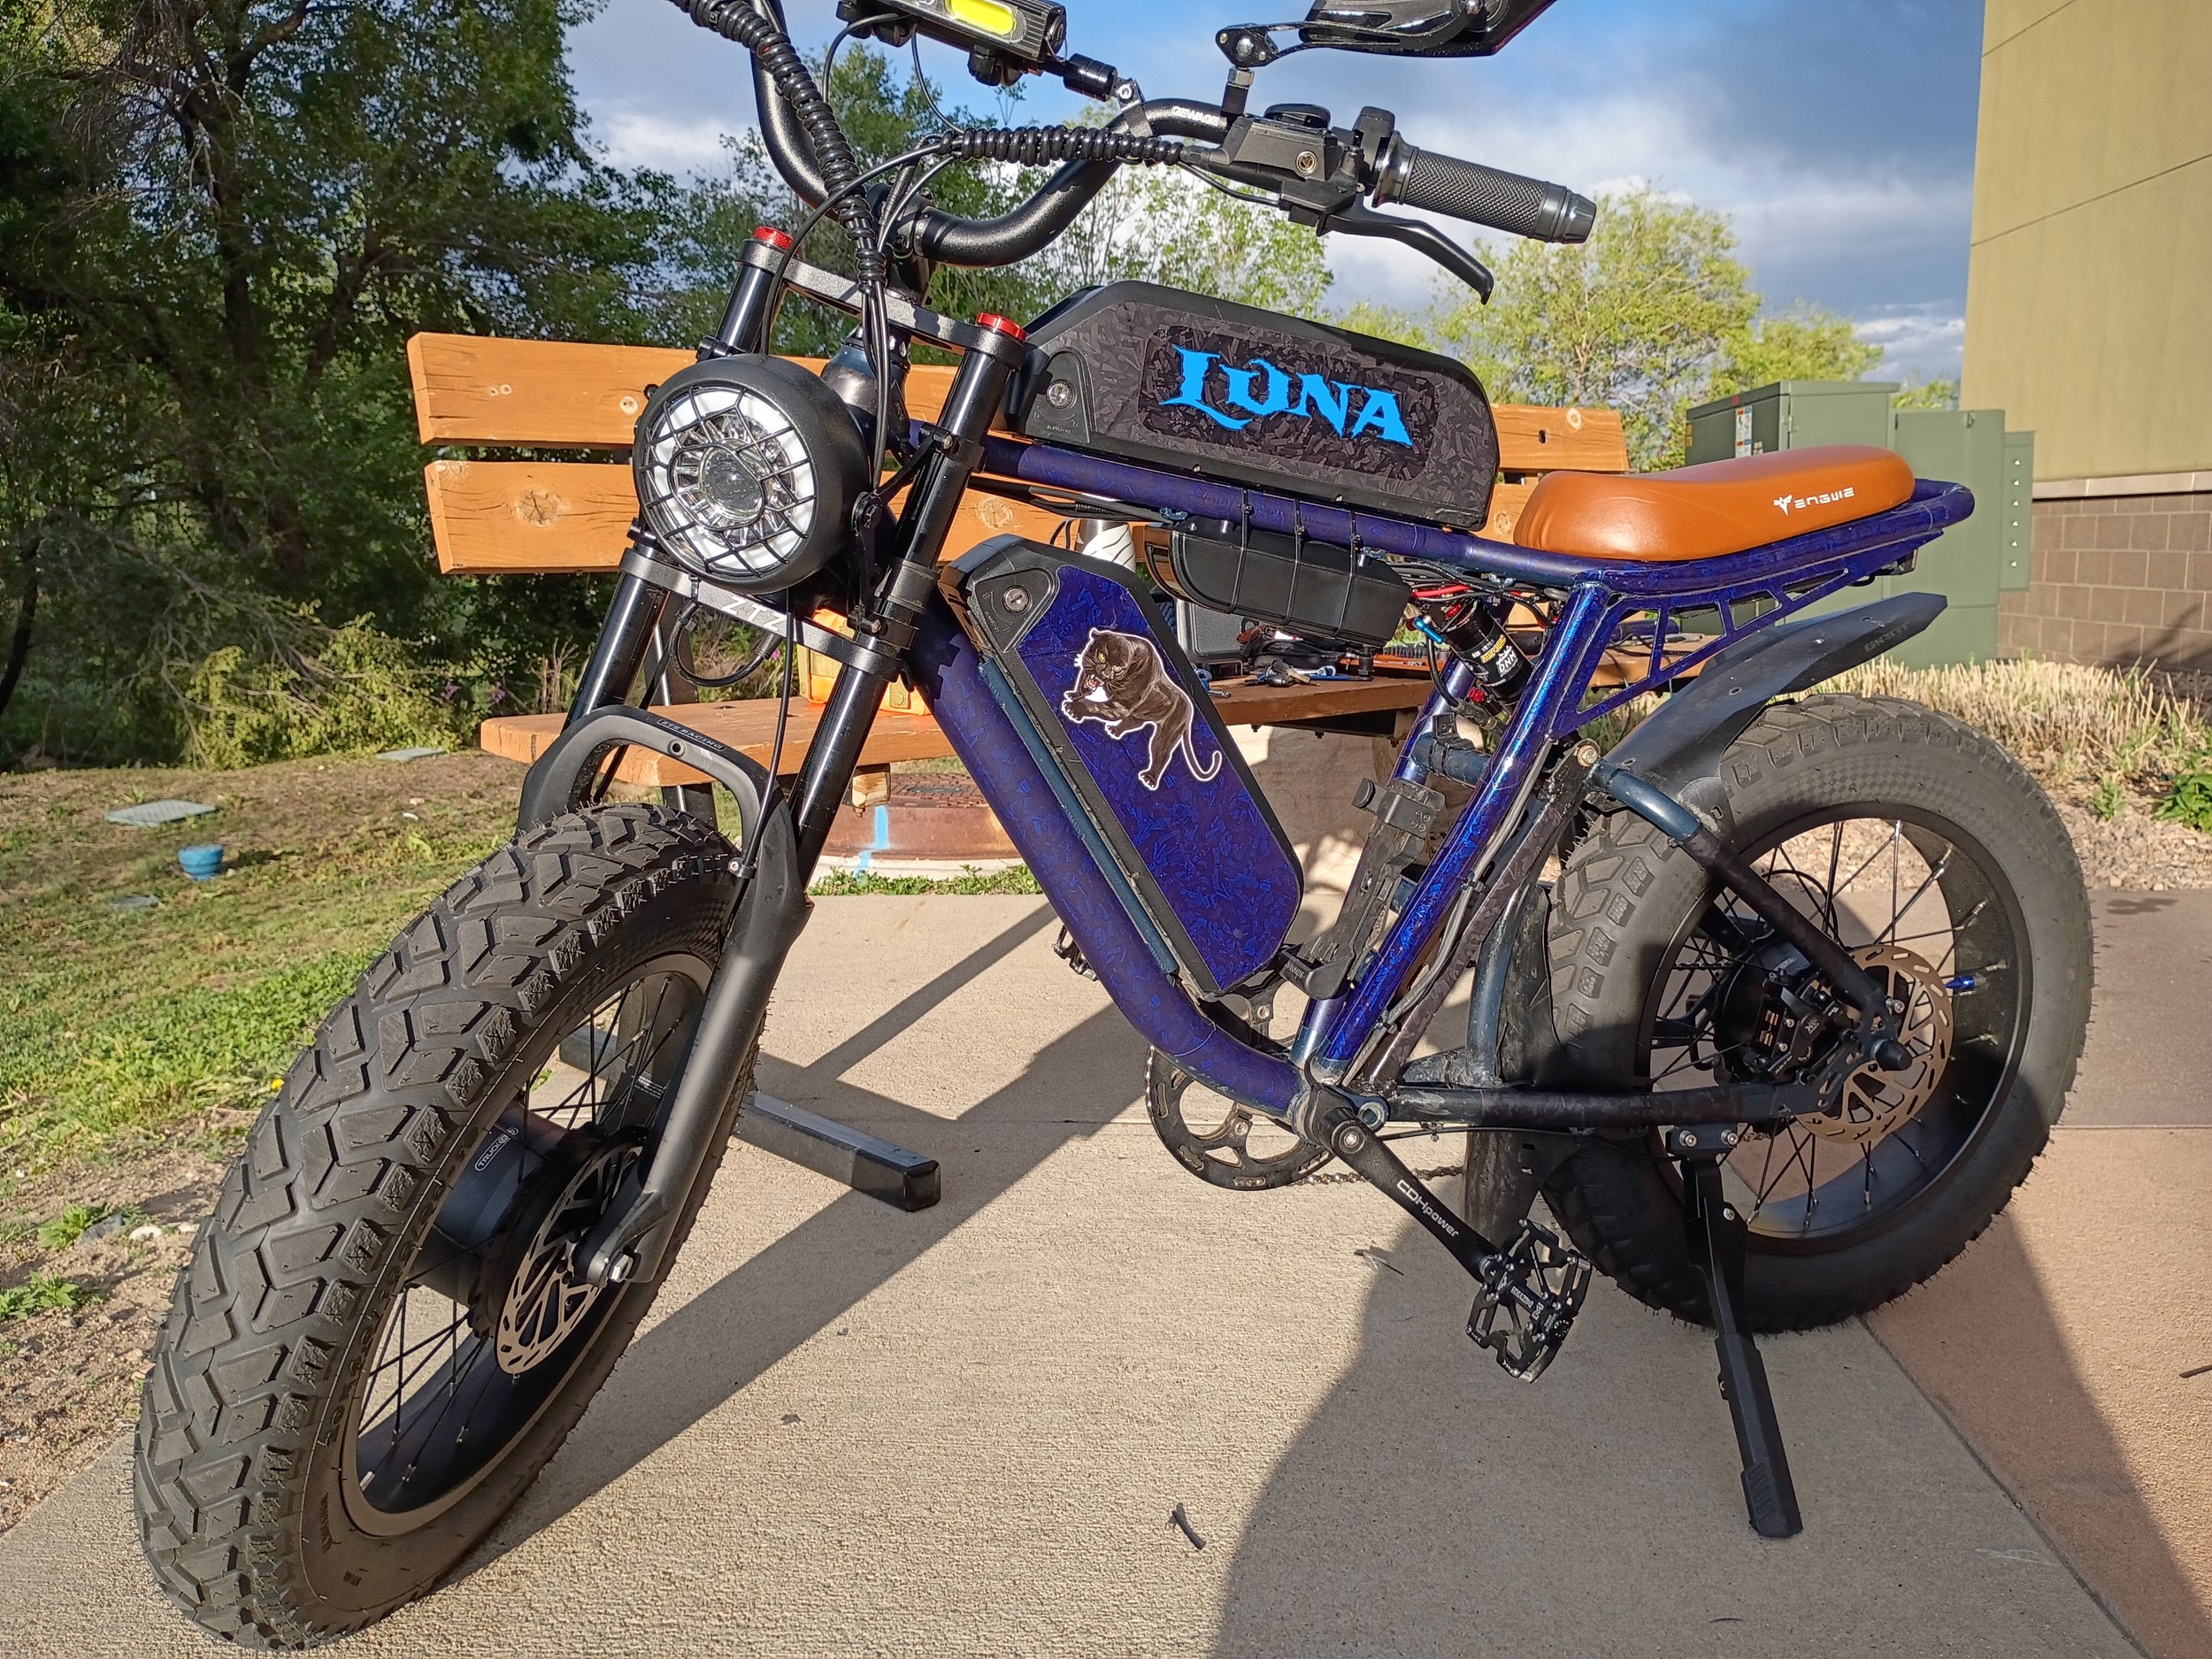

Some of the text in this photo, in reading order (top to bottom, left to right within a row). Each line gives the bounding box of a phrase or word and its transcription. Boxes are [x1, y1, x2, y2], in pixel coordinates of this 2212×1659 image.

[1171, 105, 1220, 127] GEWAGE
[1159, 344, 1414, 448] LUNA
[721, 595, 788, 632] ZTZ
[1499, 649, 1517, 673] DNM
[680, 728, 723, 749] RACING
[1397, 1179, 1459, 1237] CDHpower
